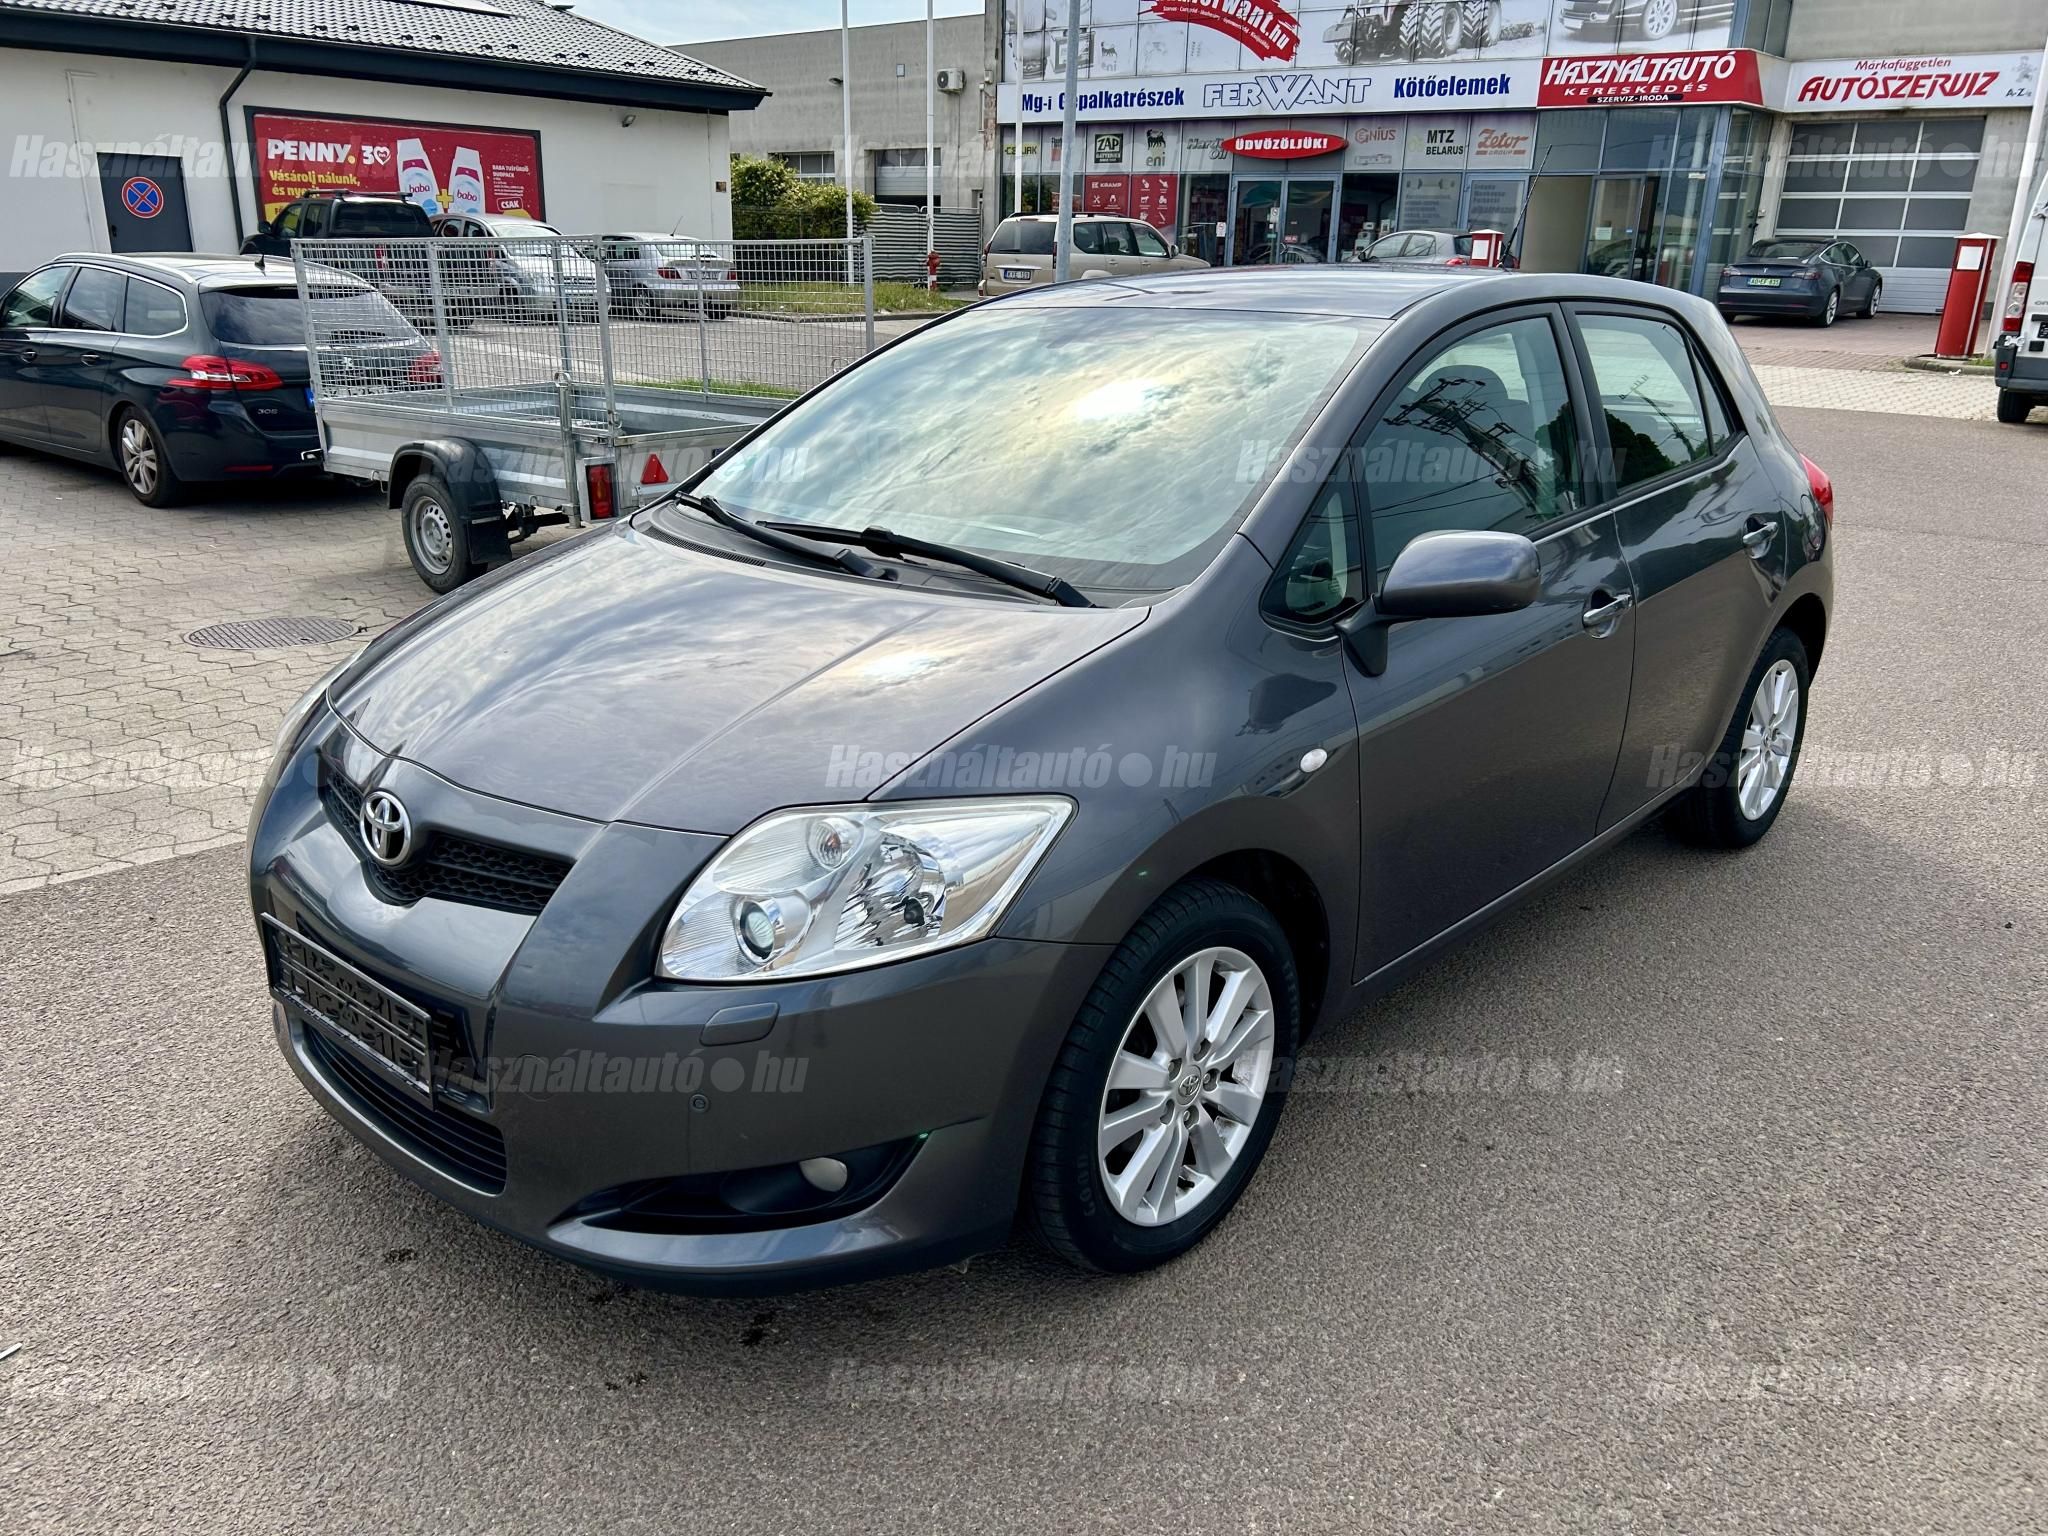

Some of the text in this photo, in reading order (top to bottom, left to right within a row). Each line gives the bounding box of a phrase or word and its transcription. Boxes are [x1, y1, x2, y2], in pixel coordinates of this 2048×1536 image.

[1543, 51, 1737, 85] HASZNÁLTAUTÓ
[1854, 57, 1951, 72] Márkafüggetlen
[1394, 73, 1512, 99] Kötőelemek
[1564, 83, 1709, 97] KERESKEDÉS
[1797, 72, 2001, 103] AUTÓSZERVIZ
[1021, 87, 1185, 113] Mg-i Gpalkatrészek
[1097, 137, 1119, 151] ZAP
[1234, 137, 1328, 151] ÜDVÖZÖLJÜK!
[1427, 130, 1456, 144] MTZ
[1477, 128, 1529, 149] Zetor
[1426, 146, 1464, 156] BELARUS
[1146, 152, 1166, 167] eni
[269, 168, 360, 187] Vásárolj nálunk,
[271, 183, 286, 196] és
[409, 184, 430, 193] baba
[457, 189, 478, 201] baba
[500, 200, 520, 209] CSAK
